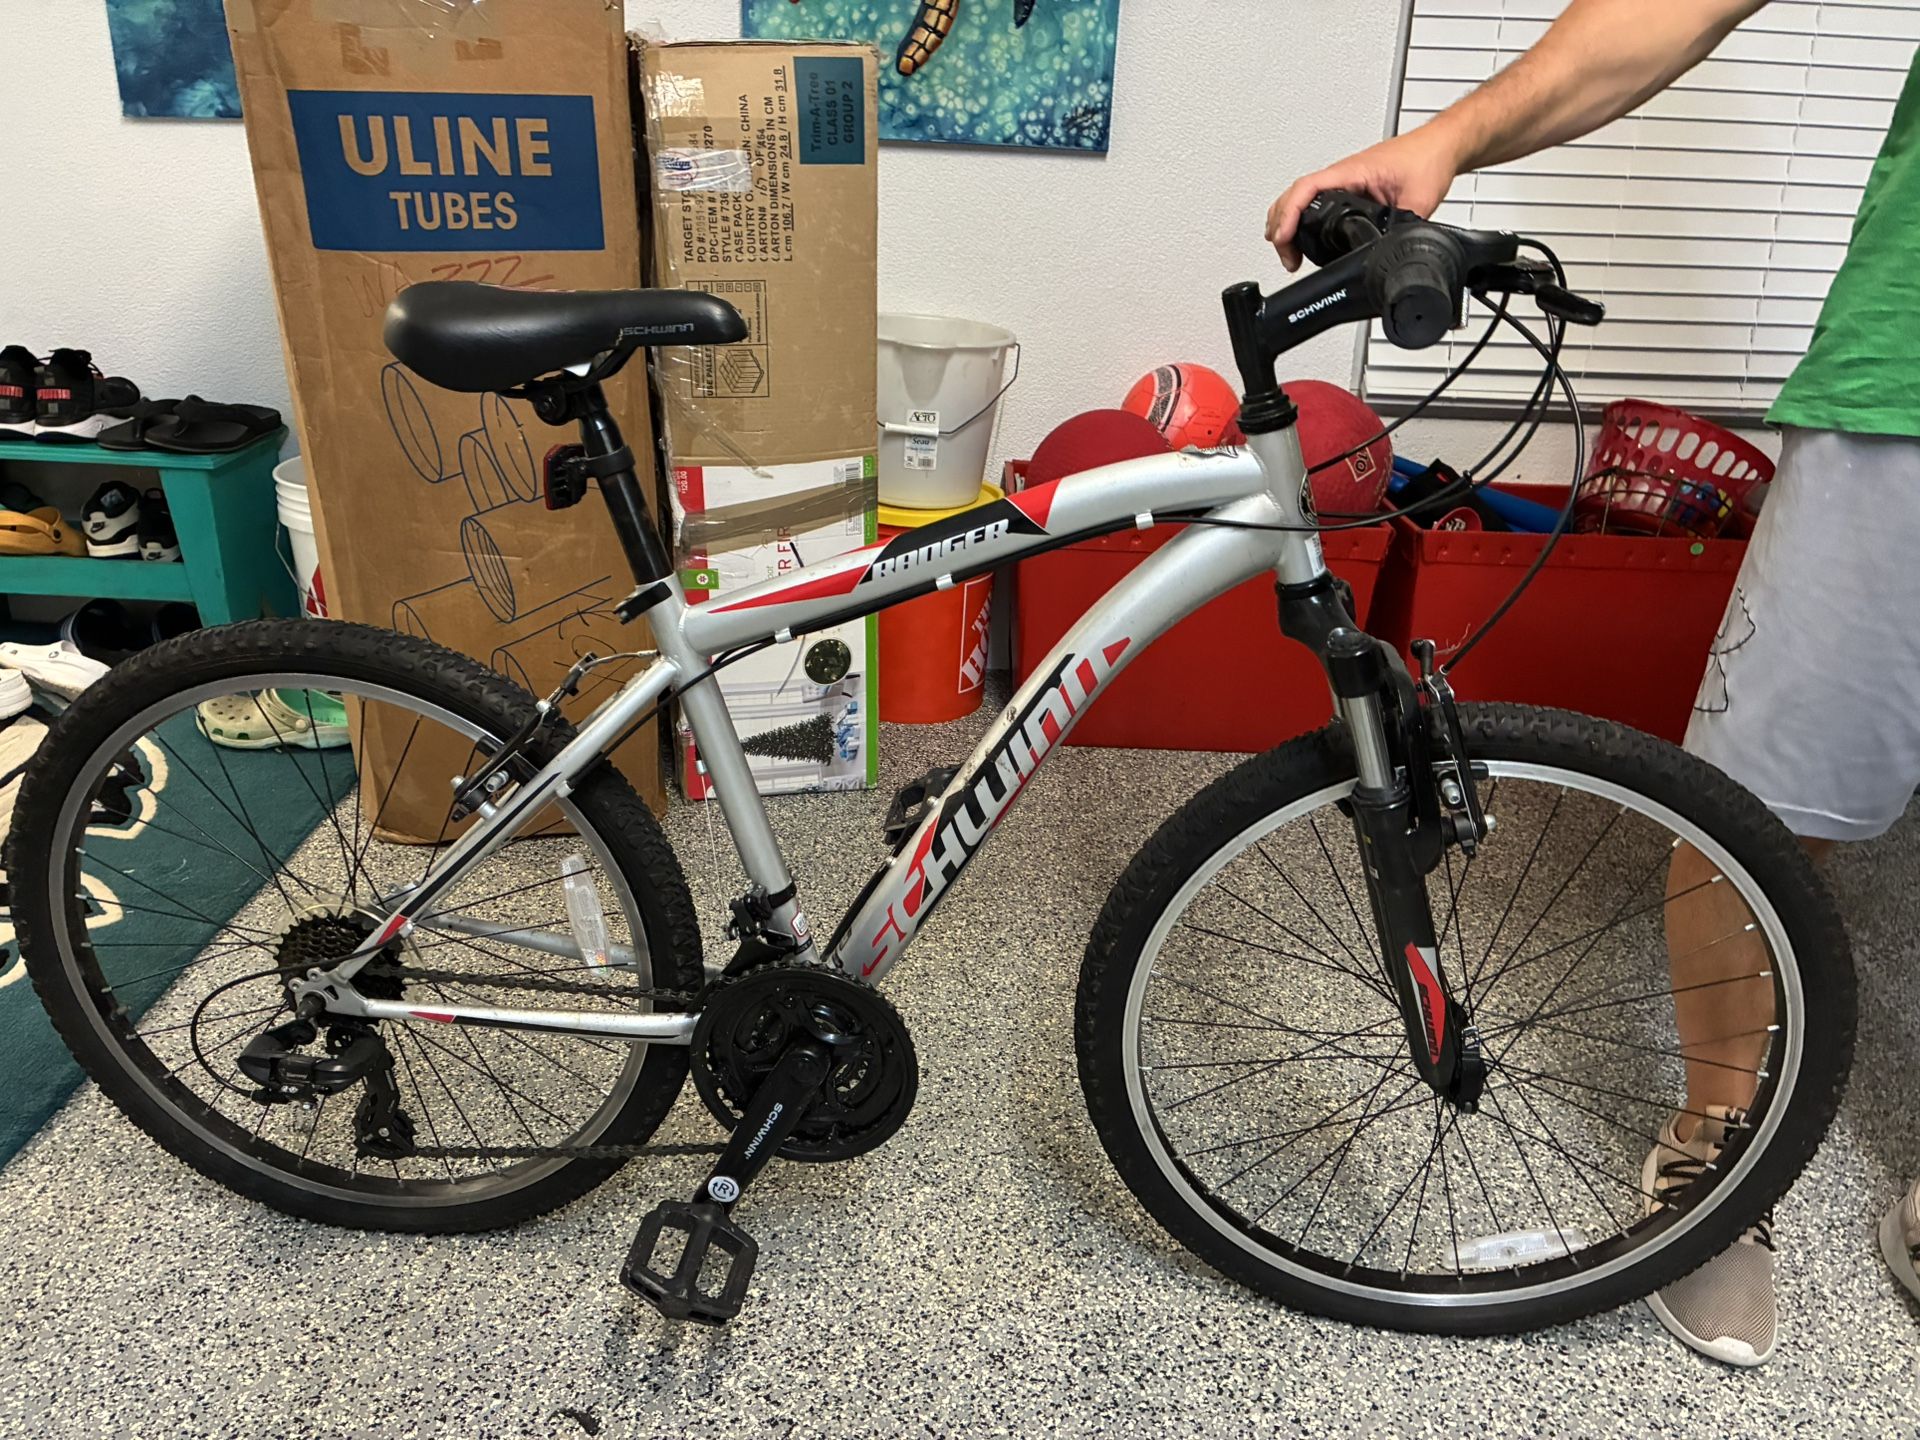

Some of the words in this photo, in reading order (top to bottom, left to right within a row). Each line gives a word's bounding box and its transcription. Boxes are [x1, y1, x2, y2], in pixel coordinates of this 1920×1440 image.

[774, 68, 785, 91] 31.8
[824, 80, 837, 95] 01
[841, 81, 853, 90] 2
[739, 94, 751, 132] CHINA
[764, 96, 774, 115] CM
[778, 95, 786, 112] cm
[842, 93, 855, 144] GROUP
[766, 119, 776, 131] IN
[778, 116, 787, 124] H
[825, 100, 838, 146] CLASS
[338, 114, 553, 178] ULINE
[779, 134, 791, 158] 24.8
[767, 134, 778, 209] DIMENSIONS
[781, 162, 790, 179] cm
[782, 182, 790, 193] W
[389, 191, 518, 231] TUBES
[782, 203, 793, 231] 106.7
[683, 216, 694, 263] TARGET
[721, 225, 732, 263] STYLE
[734, 231, 744, 263] CASE
[746, 205, 757, 262] COUNTRY
[771, 213, 781, 262] CARTON
[785, 235, 792, 252] cm
[697, 246, 706, 263] PO
[1288, 288, 1347, 323] SCHWINN
[623, 322, 694, 336] SCHWINN
[777, 526, 792, 553] FIR
[872, 518, 1009, 580] RANGER
[861, 646, 1112, 977] SCHWINN
[744, 1102, 783, 1160] SCHWINN
